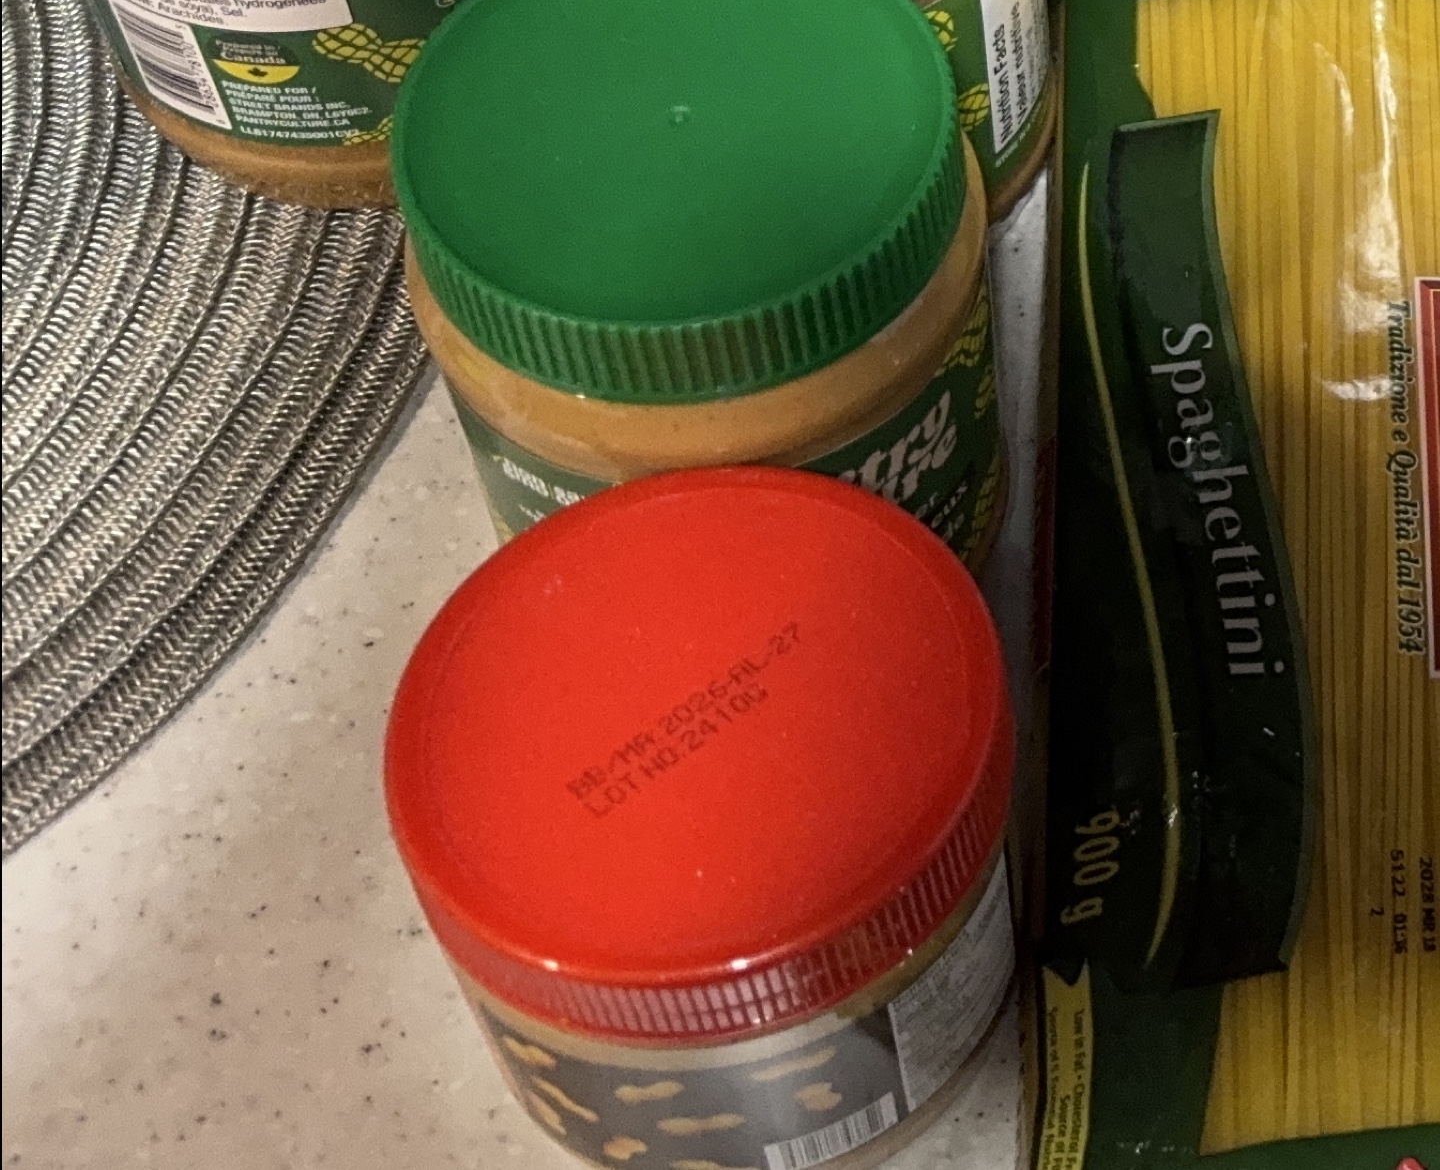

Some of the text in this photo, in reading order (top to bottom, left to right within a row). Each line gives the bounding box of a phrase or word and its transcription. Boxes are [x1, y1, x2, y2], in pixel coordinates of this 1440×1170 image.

[1149, 322, 1285, 678] Spaghettini
[1386, 300, 1425, 655] Tradizione Qualità 1954
[583, 772, 641, 818] LOT
